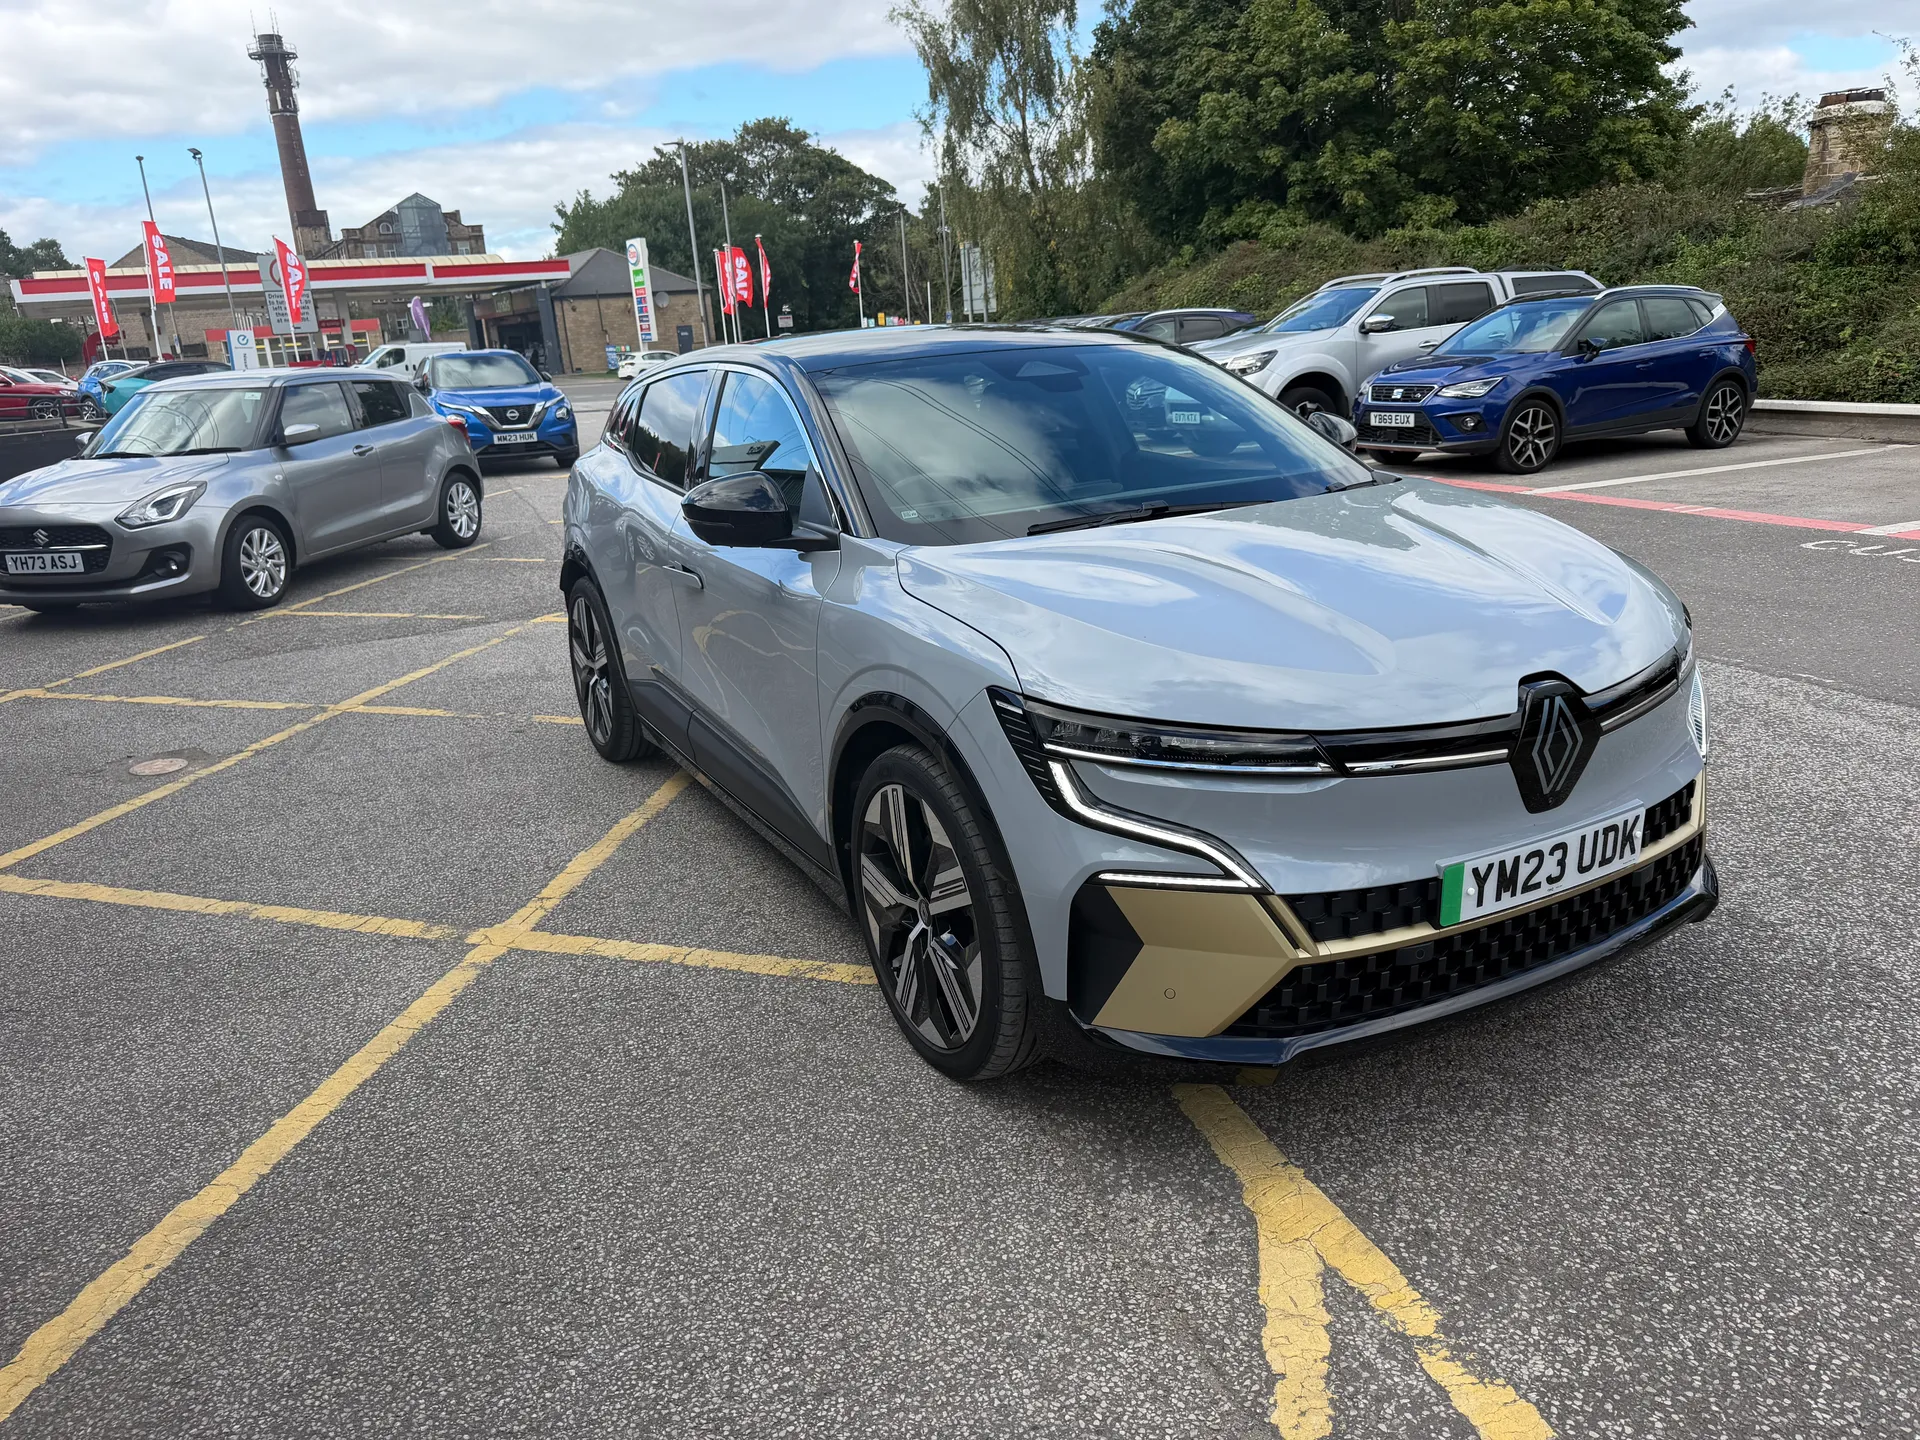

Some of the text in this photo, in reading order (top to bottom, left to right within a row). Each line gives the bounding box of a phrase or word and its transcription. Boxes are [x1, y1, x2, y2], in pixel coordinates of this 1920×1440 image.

[152, 234, 173, 290] SALE
[1373, 414, 1411, 425] YB69 EUX
[519, 433, 534, 441] HUK
[11, 555, 77, 570] YH73 ASJ
[1471, 814, 1641, 909] YM23 UDK
